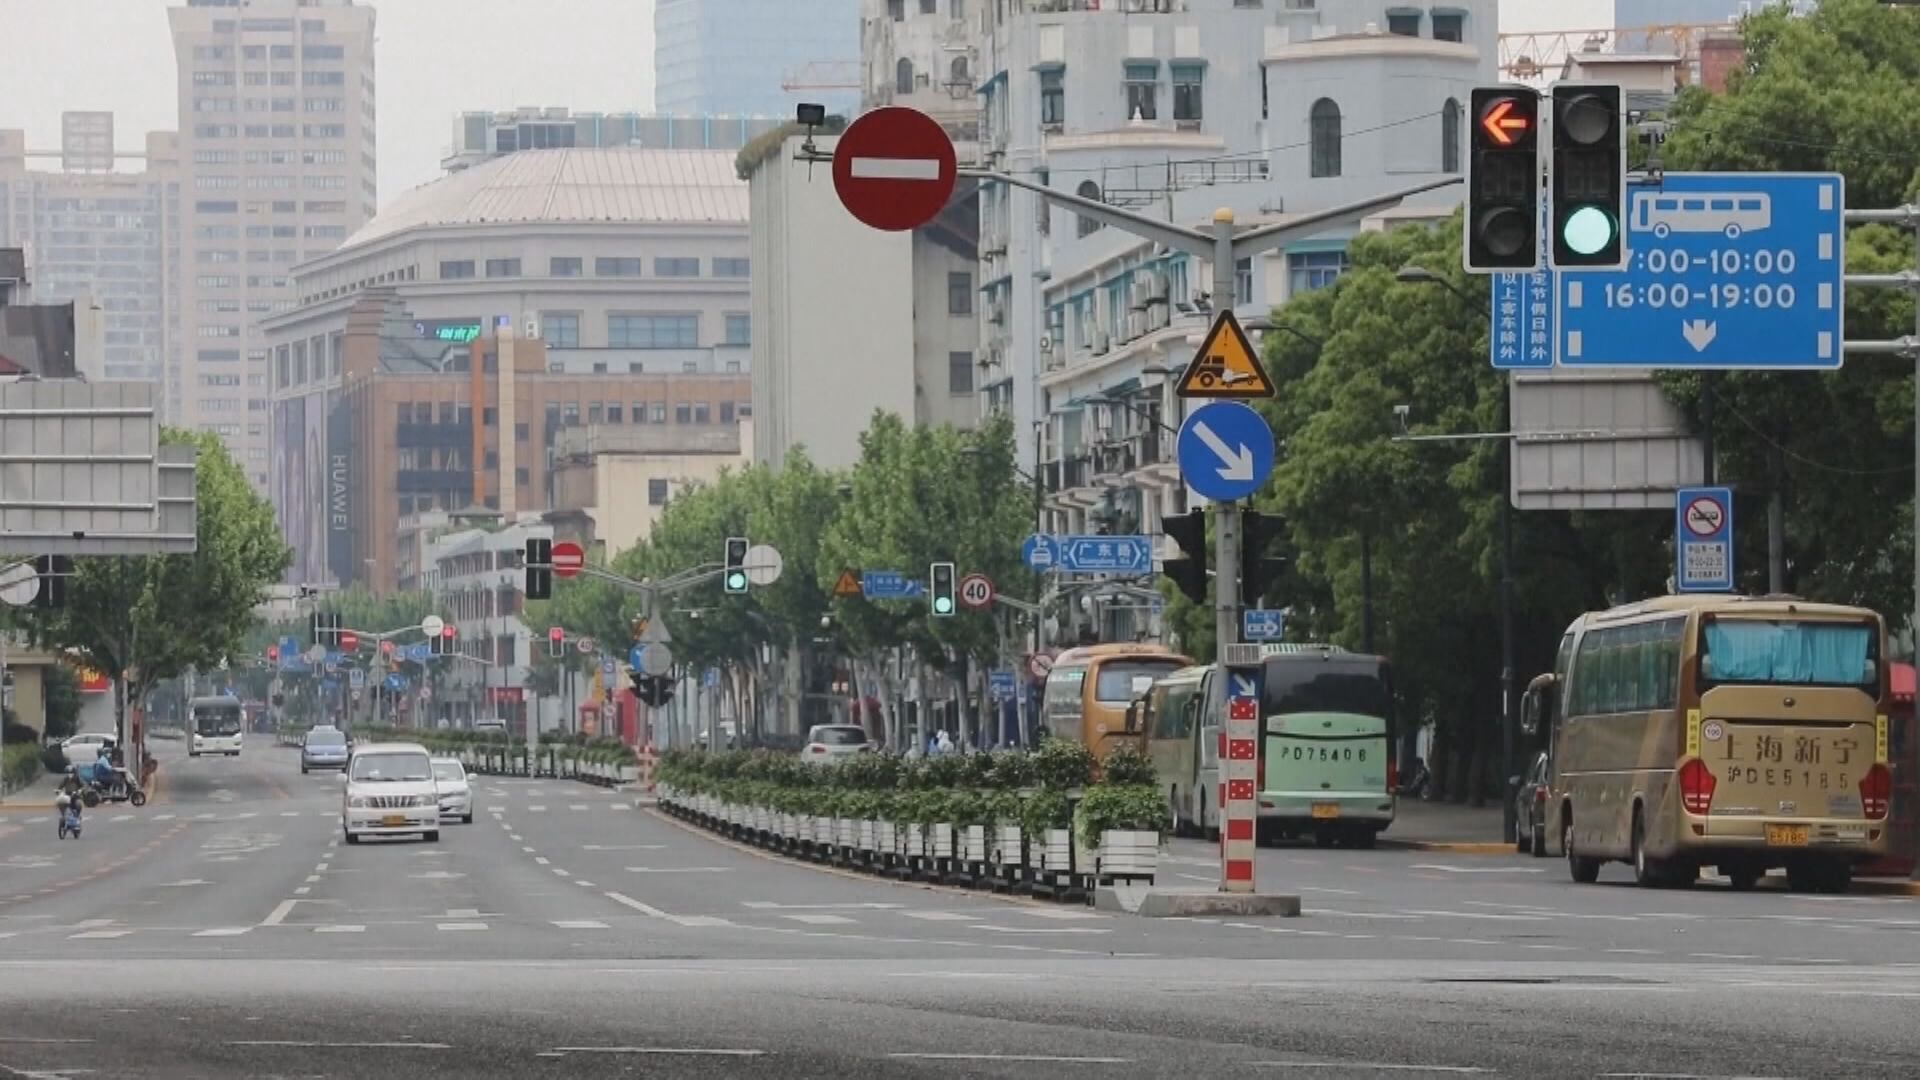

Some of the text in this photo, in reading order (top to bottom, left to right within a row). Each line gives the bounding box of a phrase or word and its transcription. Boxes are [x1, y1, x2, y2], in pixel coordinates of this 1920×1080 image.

[1605, 283, 1796, 308] 16:00-19:00
[333, 455, 347, 530] HUAWEI
[966, 583, 986, 599] 40
[1717, 734, 1858, 764] 上海新宁
[1728, 766, 1848, 789] 沪DE5185
